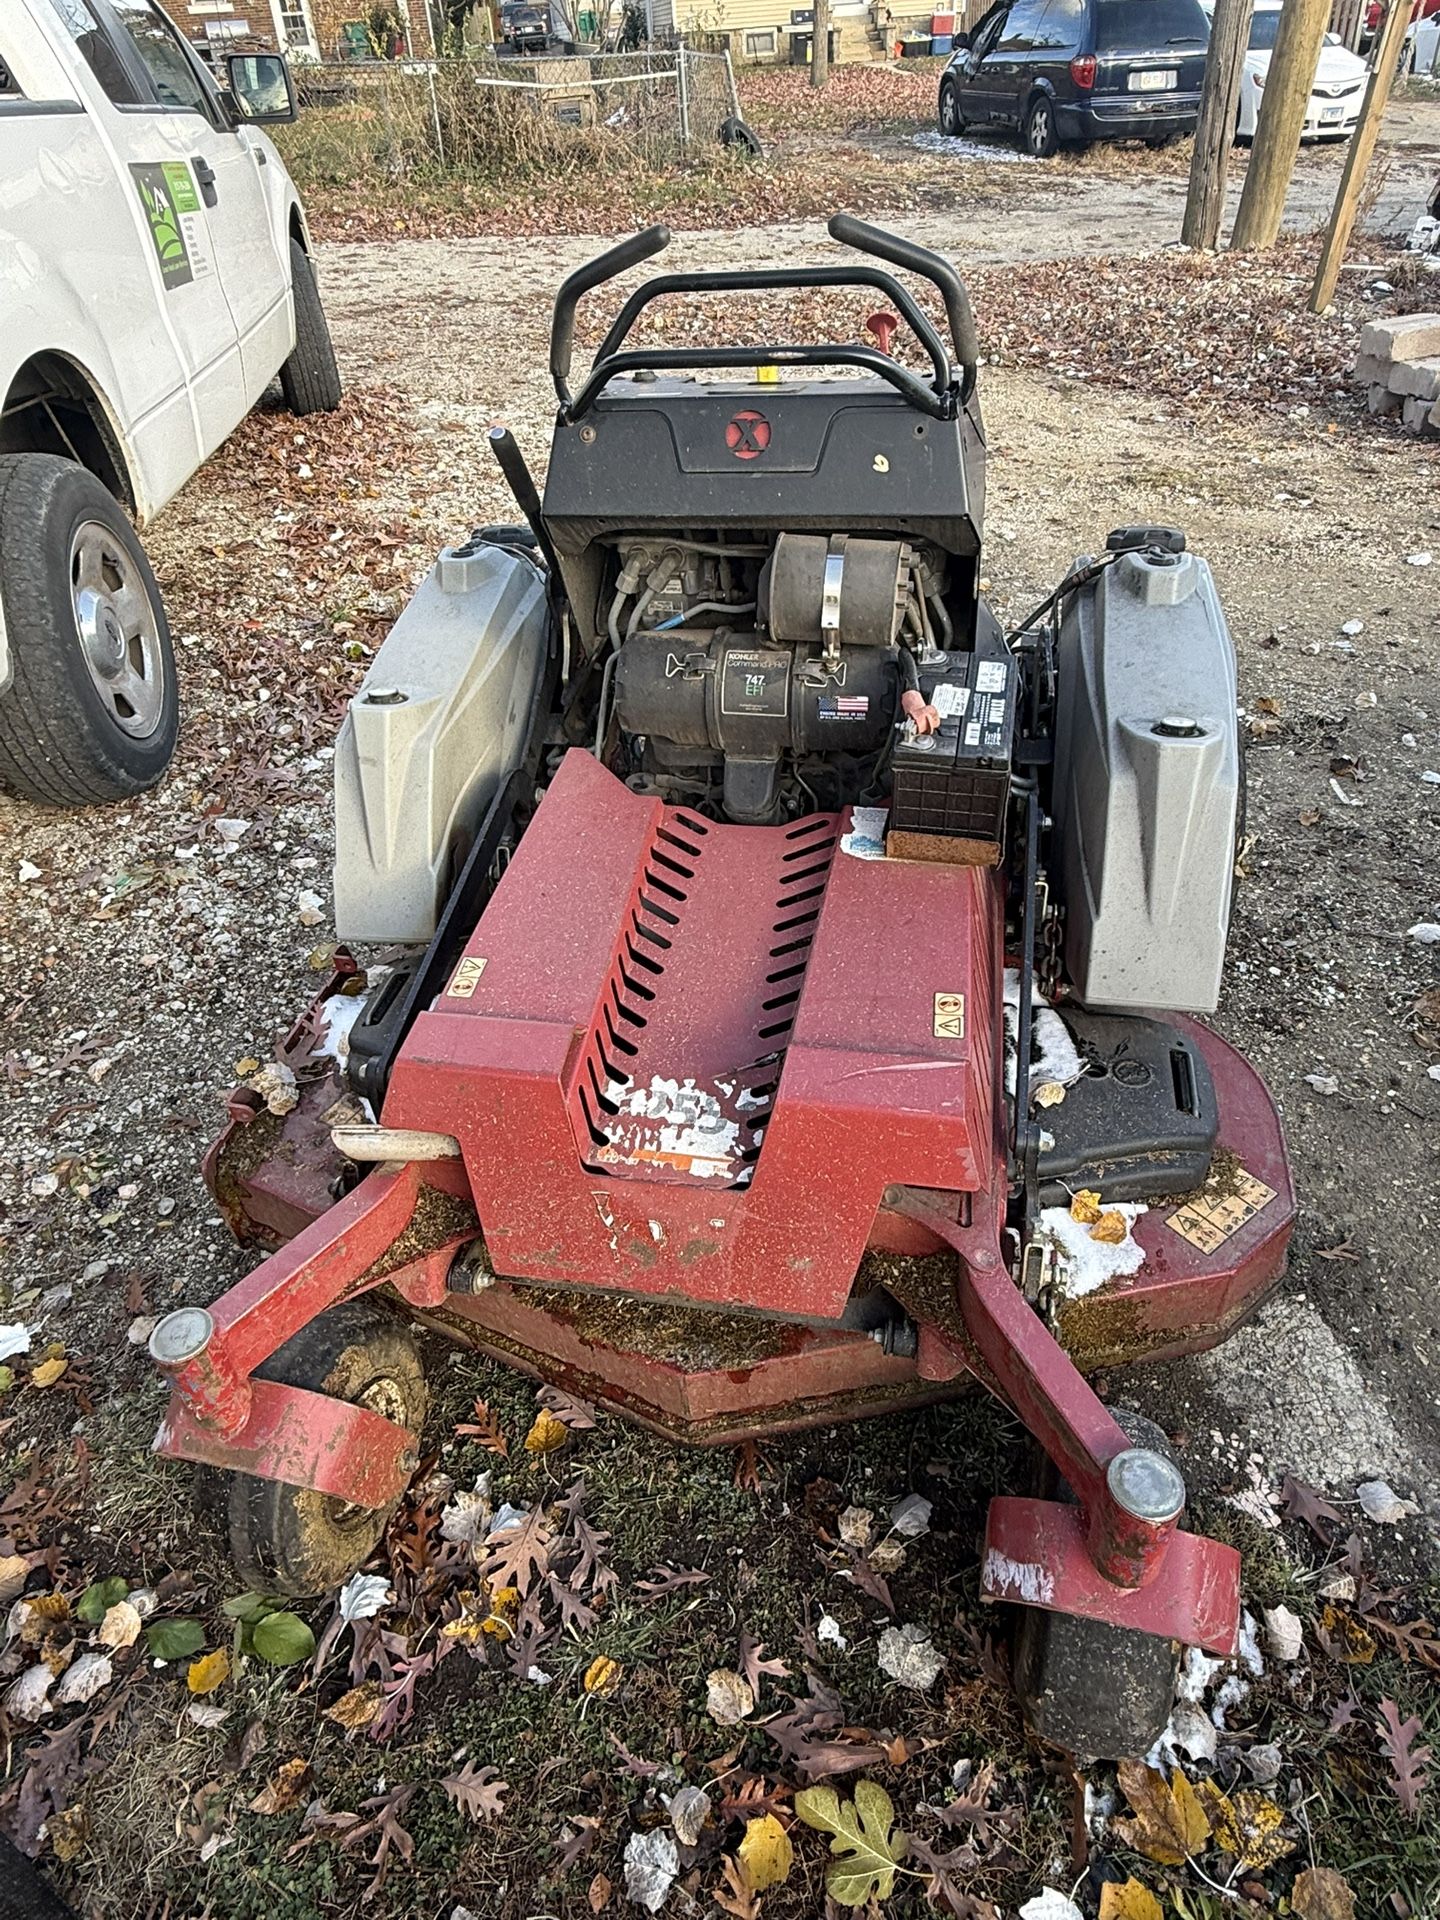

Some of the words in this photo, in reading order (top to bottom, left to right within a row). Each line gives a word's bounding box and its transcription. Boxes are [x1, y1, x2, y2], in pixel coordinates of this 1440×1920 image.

[728, 653, 760, 661] KOHLER
[745, 684, 763, 696] EFI
[989, 699, 1006, 724] TITAN
